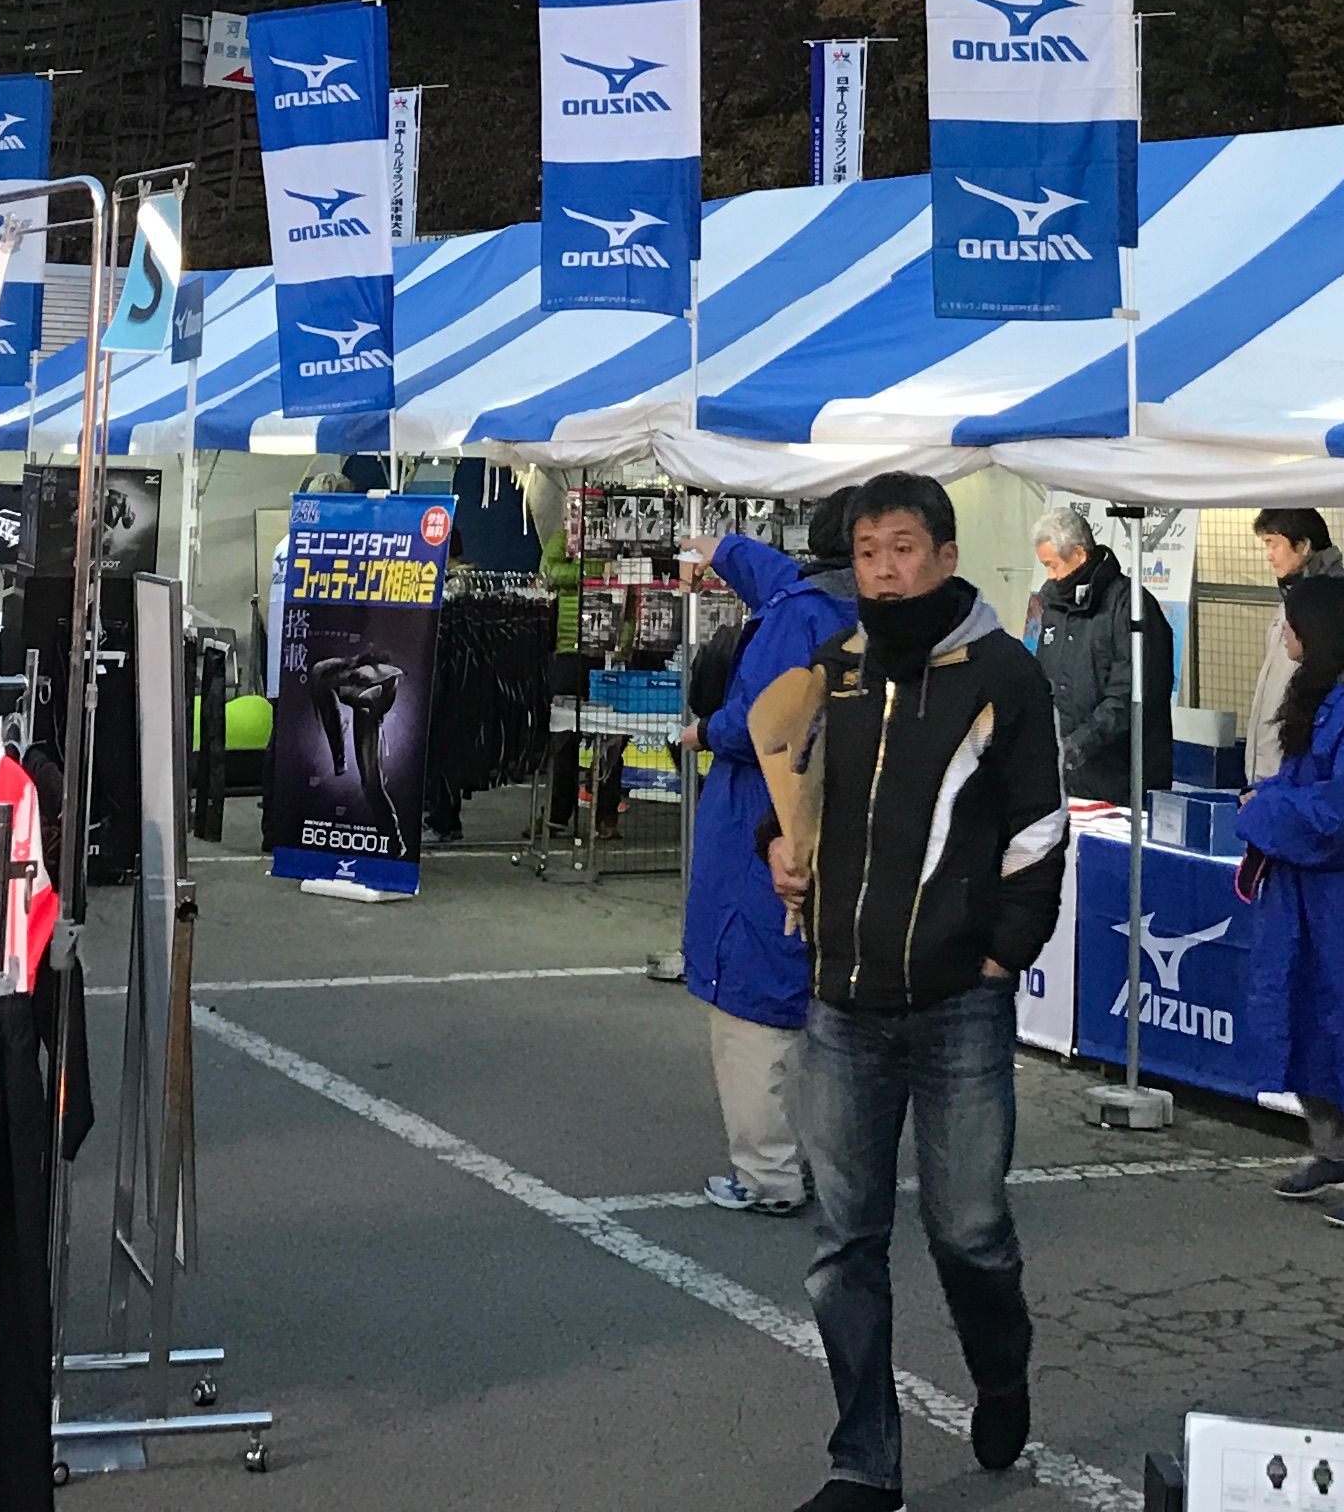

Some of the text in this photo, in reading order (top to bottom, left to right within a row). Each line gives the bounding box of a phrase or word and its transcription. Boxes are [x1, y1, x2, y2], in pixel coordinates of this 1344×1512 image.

[295, 532, 412, 557] ランニングタイツ
[293, 558, 439, 603] フィッティング相談会
